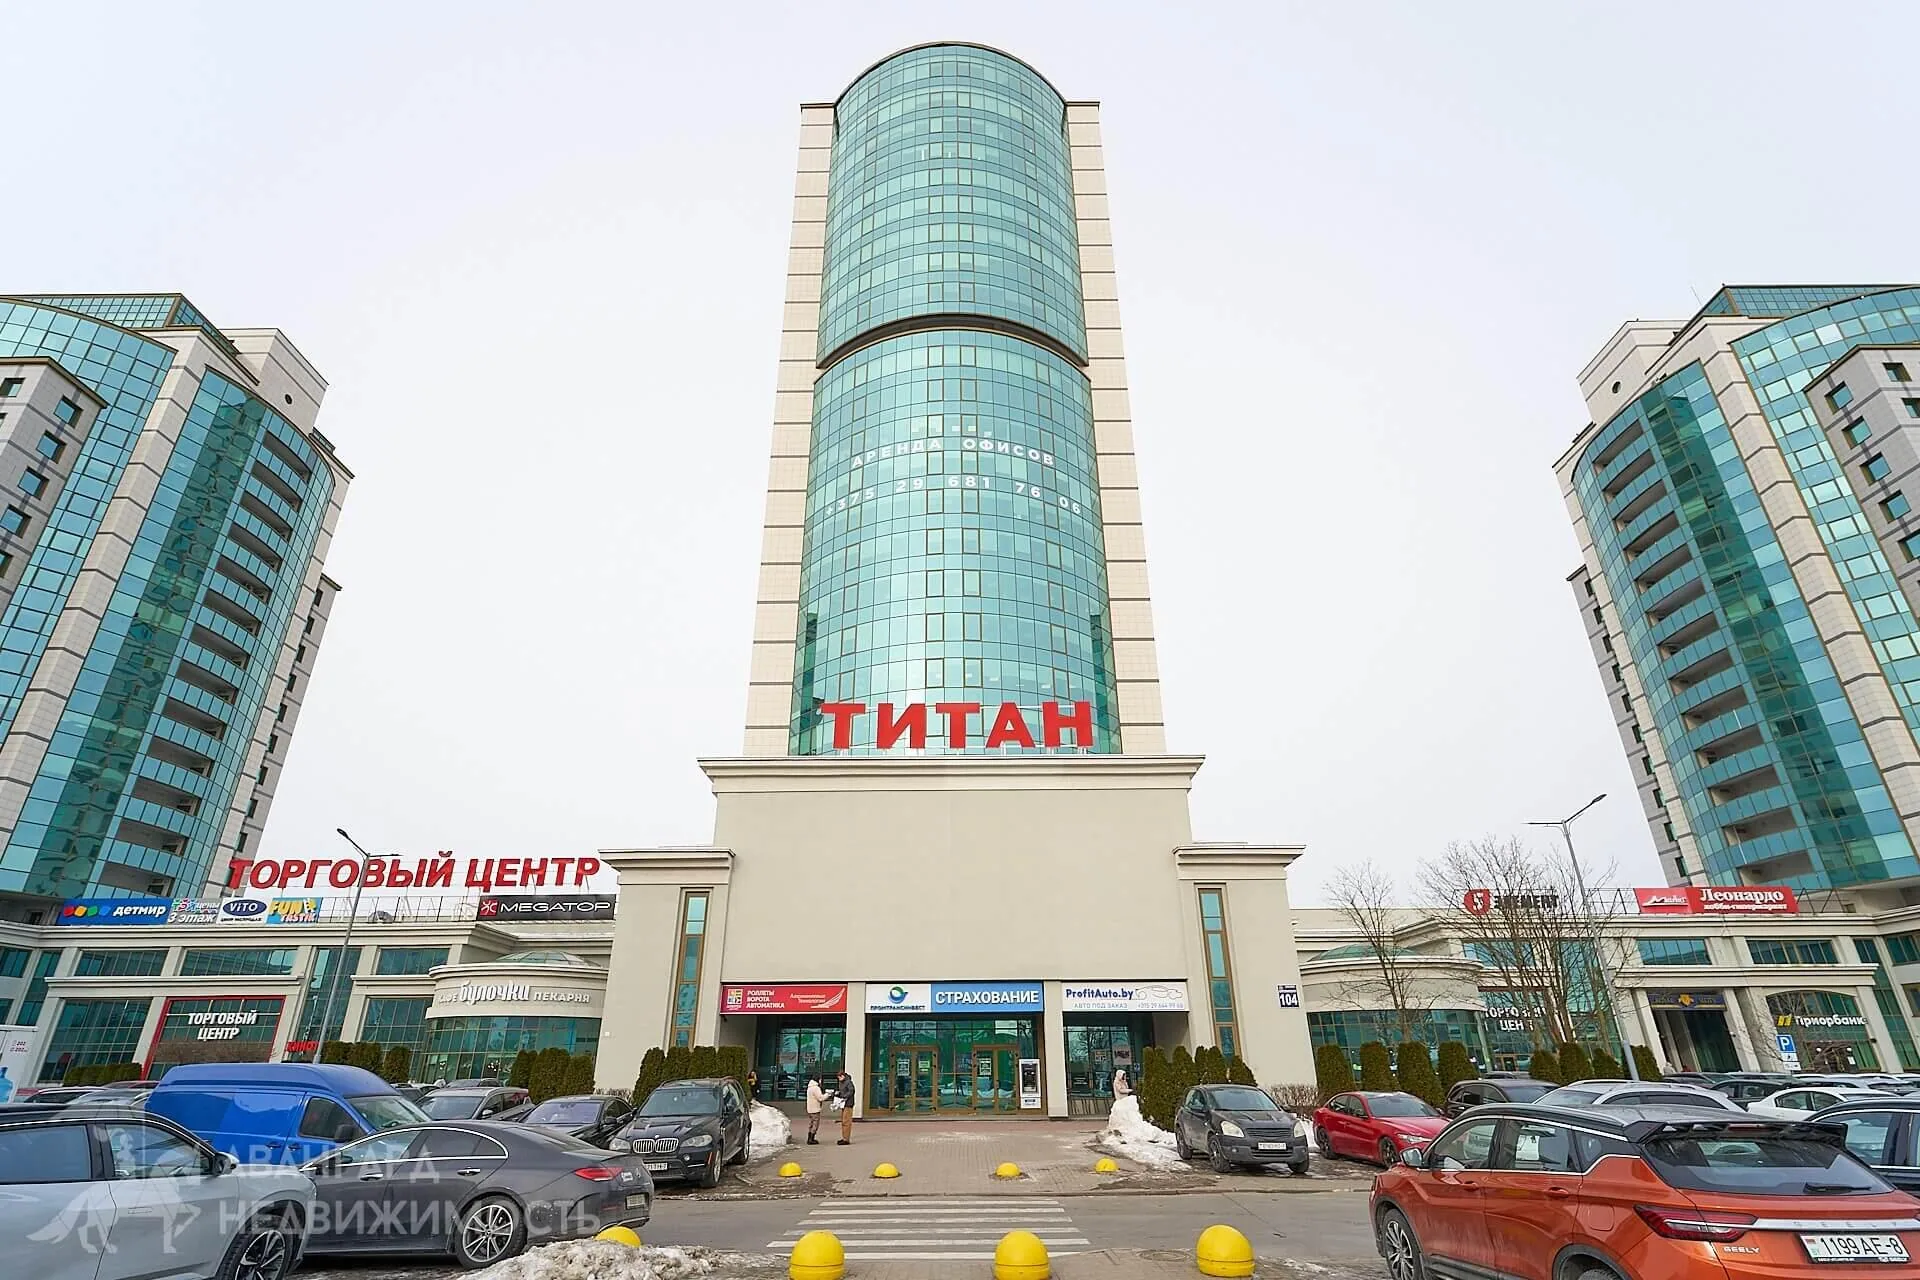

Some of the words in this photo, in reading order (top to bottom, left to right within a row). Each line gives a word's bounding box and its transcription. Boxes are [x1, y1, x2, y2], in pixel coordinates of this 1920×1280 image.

[852, 440, 942, 468] АРЕНДА
[963, 438, 1055, 466] ОФИСОВ
[825, 486, 875, 516] +375
[896, 479, 924, 493] 29
[948, 476, 990, 489] 681
[1015, 482, 1042, 499] 76
[1059, 495, 1082, 515] 06
[821, 701, 1094, 749] ТИТАН
[228, 850, 454, 890] ТОРГОВЫЙ
[465, 857, 600, 893] ЦЕНТР
[1700, 888, 1784, 904] Леонардо
[113, 905, 166, 917] детмир
[270, 901, 303, 915] FUN
[500, 902, 611, 912] MEGATOP
[167, 912, 178, 924] 3
[179, 913, 218, 924] этаж
[460, 980, 530, 1005] булочки
[533, 991, 590, 1003] ПЕКАРНЯ
[935, 991, 1040, 1005] СТРАХОВАНИЕ
[1065, 988, 1134, 1001] ProfitAuto.by
[1280, 993, 1298, 1006] 104
[187, 1009, 257, 1025] ТОРГОВЫЙ
[1794, 1013, 1867, 1027] Приорбанк
[1500, 1019, 1535, 1032] ЦЕНТ
[197, 1027, 240, 1041] ЦЕНТР
[1780, 1037, 1791, 1051] P
[1723, 1246, 1760, 1254] GEELY
[1821, 1238, 1861, 1255] 1199
[1860, 1237, 1903, 1255] AE-8
